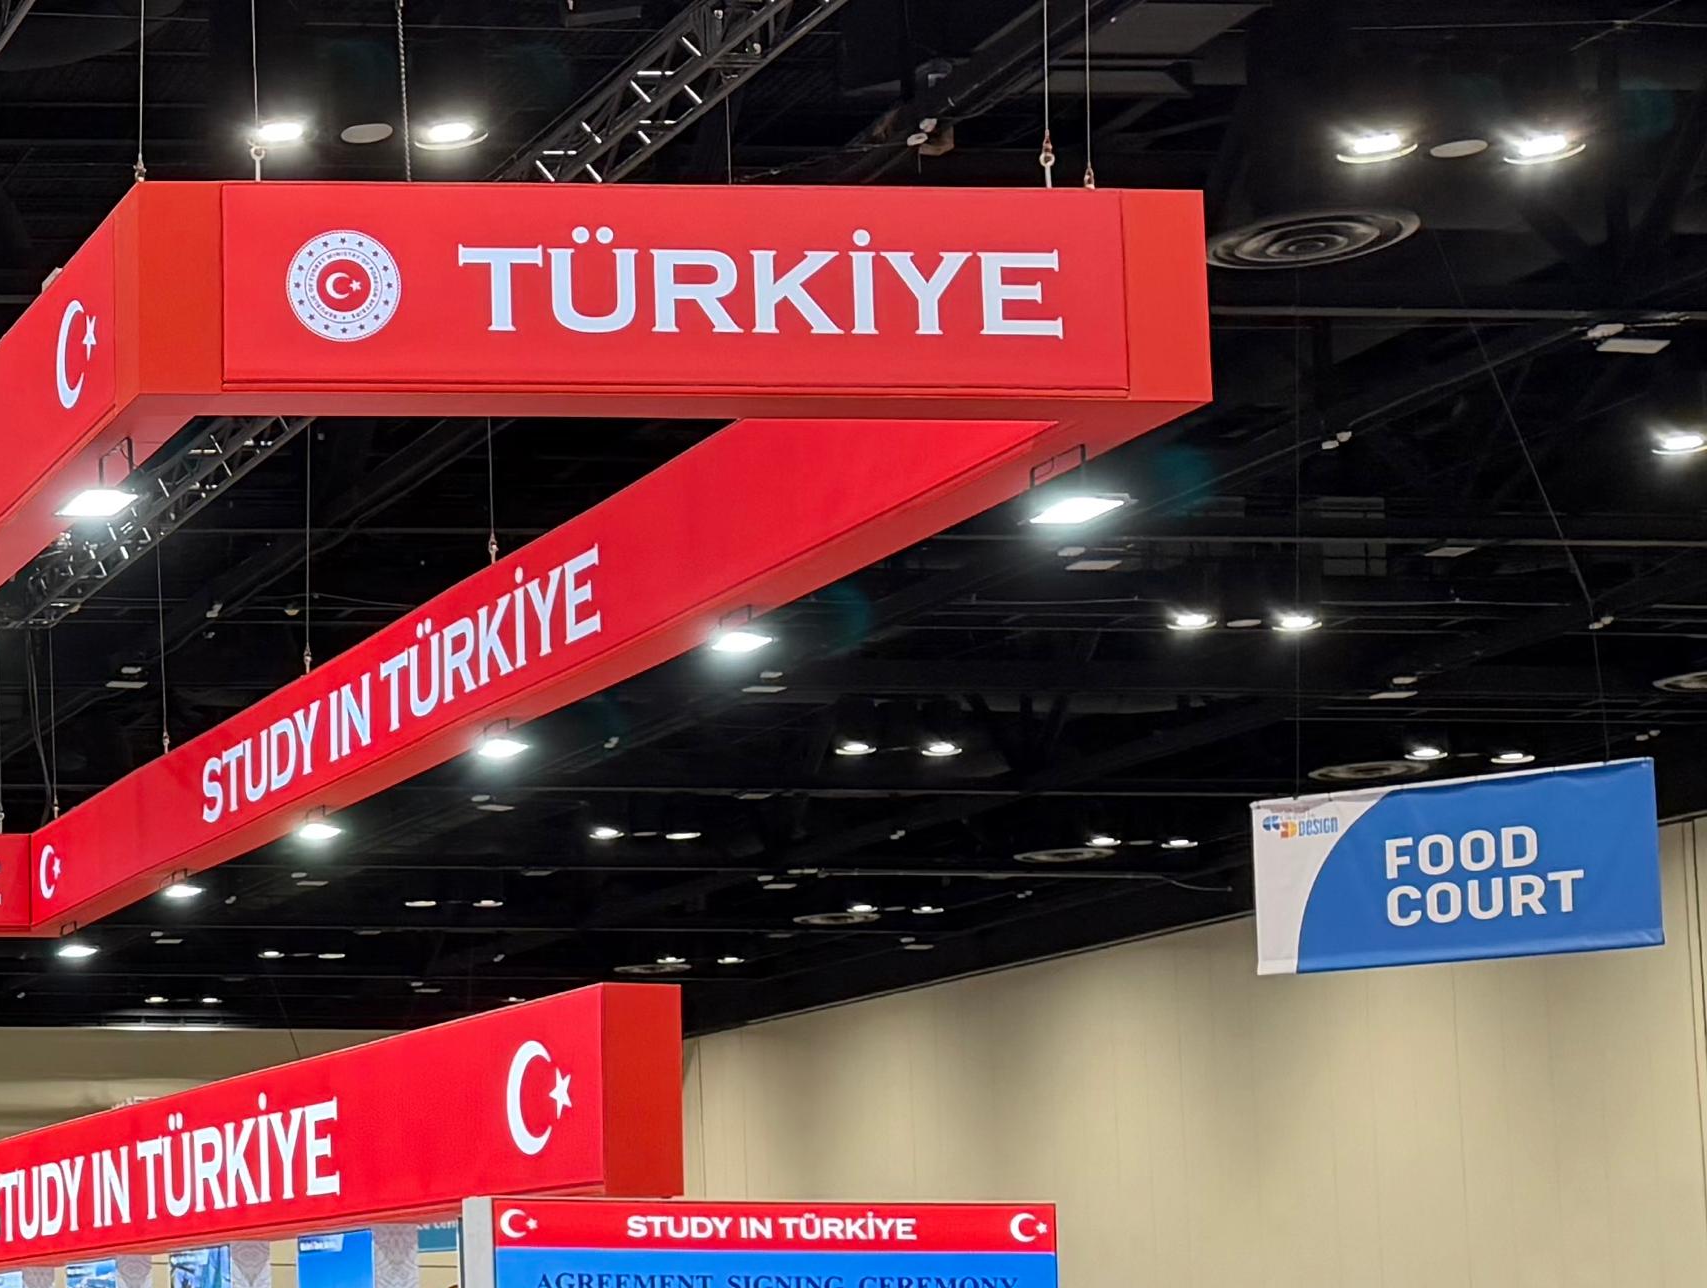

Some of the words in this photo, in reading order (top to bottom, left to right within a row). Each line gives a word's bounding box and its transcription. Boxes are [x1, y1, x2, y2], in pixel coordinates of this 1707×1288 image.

[458, 226, 1064, 340] TÜRKİYE
[202, 700, 321, 823] STUDY
[329, 671, 372, 763] IN
[380, 543, 602, 732] TÜRKİYE
[1385, 825, 1539, 880] FOOD
[1387, 869, 1585, 927] COURT
[92, 1145, 131, 1226] IN
[137, 1092, 341, 1219] TÜRKİYE
[626, 1214, 732, 1239] STUDY
[739, 1215, 772, 1239] IN
[777, 1211, 917, 1241] TÜRKİYE
